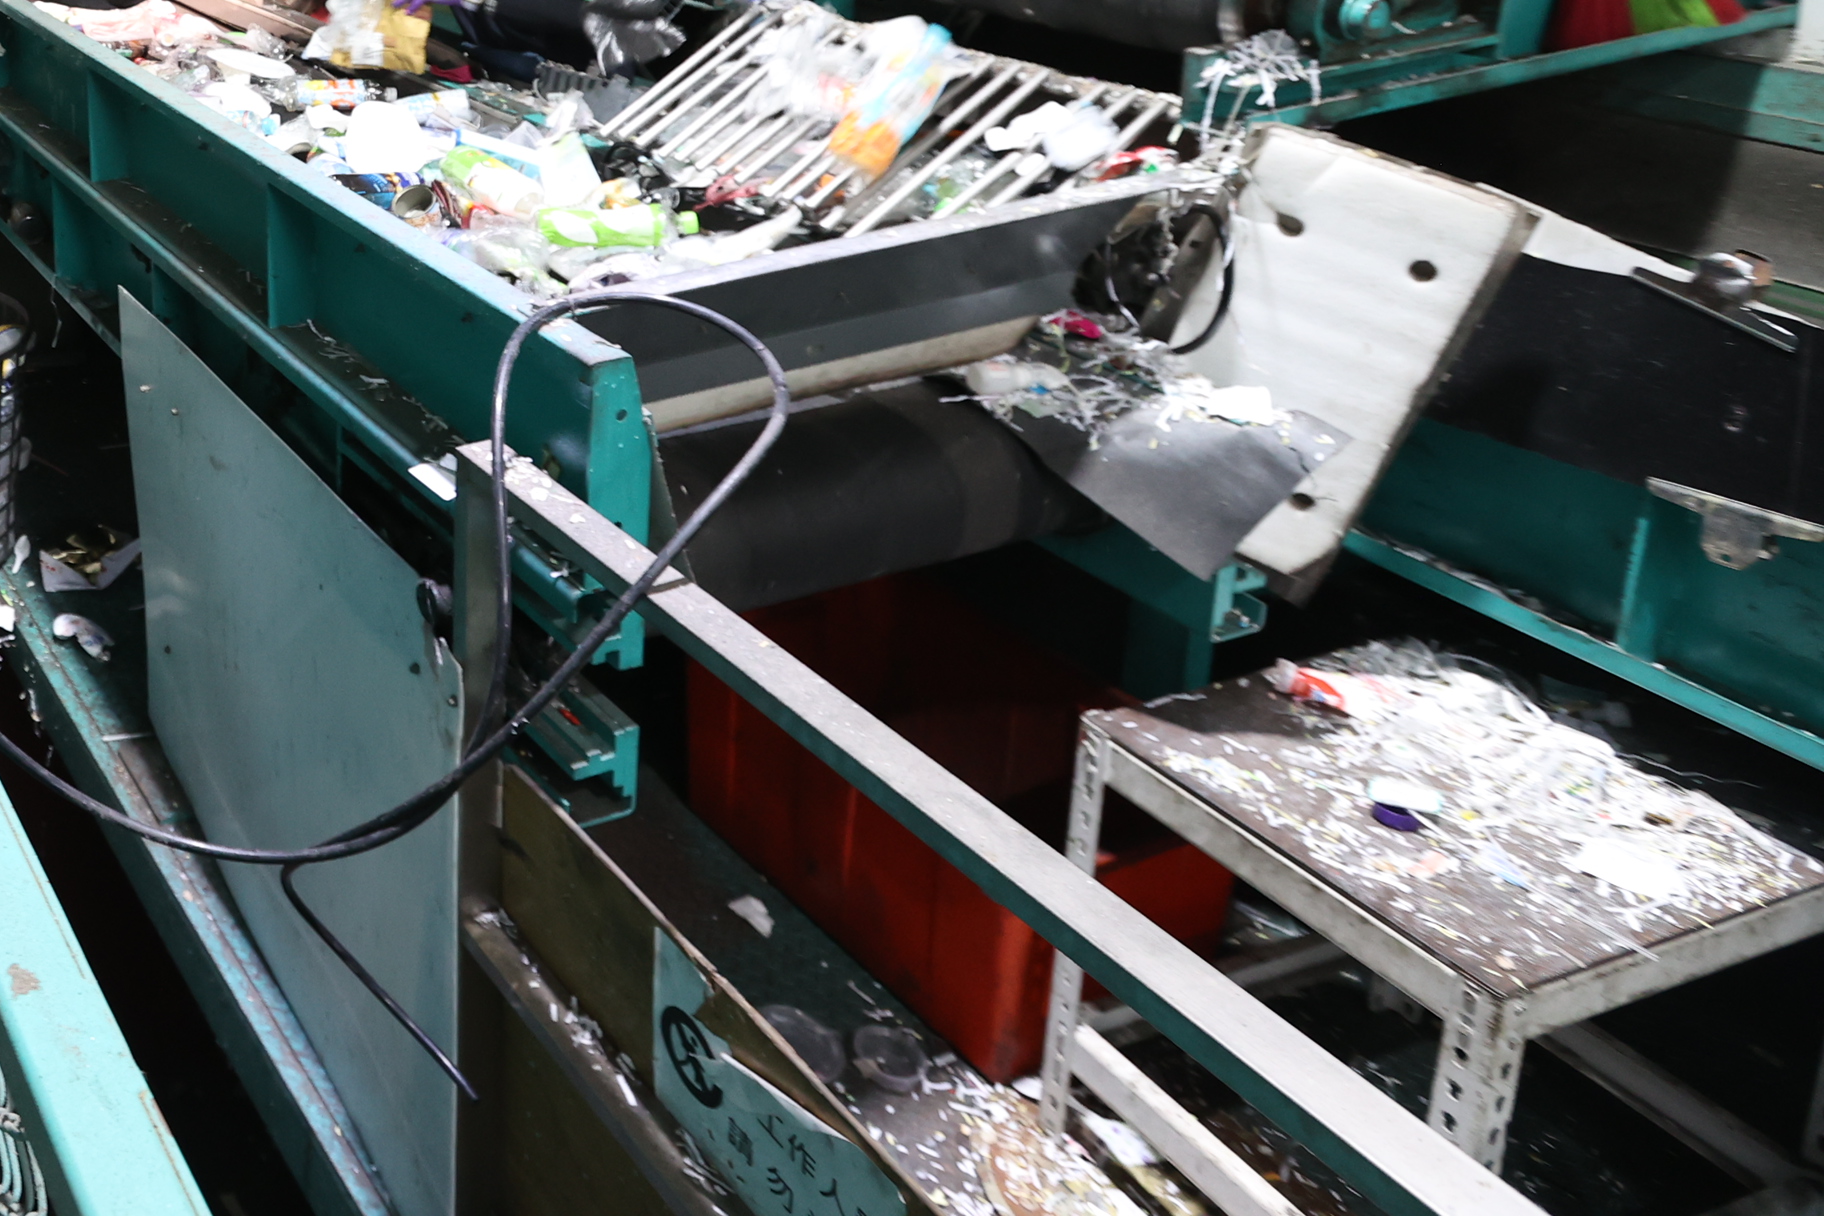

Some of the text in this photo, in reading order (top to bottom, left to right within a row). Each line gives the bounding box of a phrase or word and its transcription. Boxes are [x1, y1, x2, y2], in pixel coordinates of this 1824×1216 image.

[727, 1116, 815, 1216] 請勿
[757, 1114, 867, 1216] 工作人
